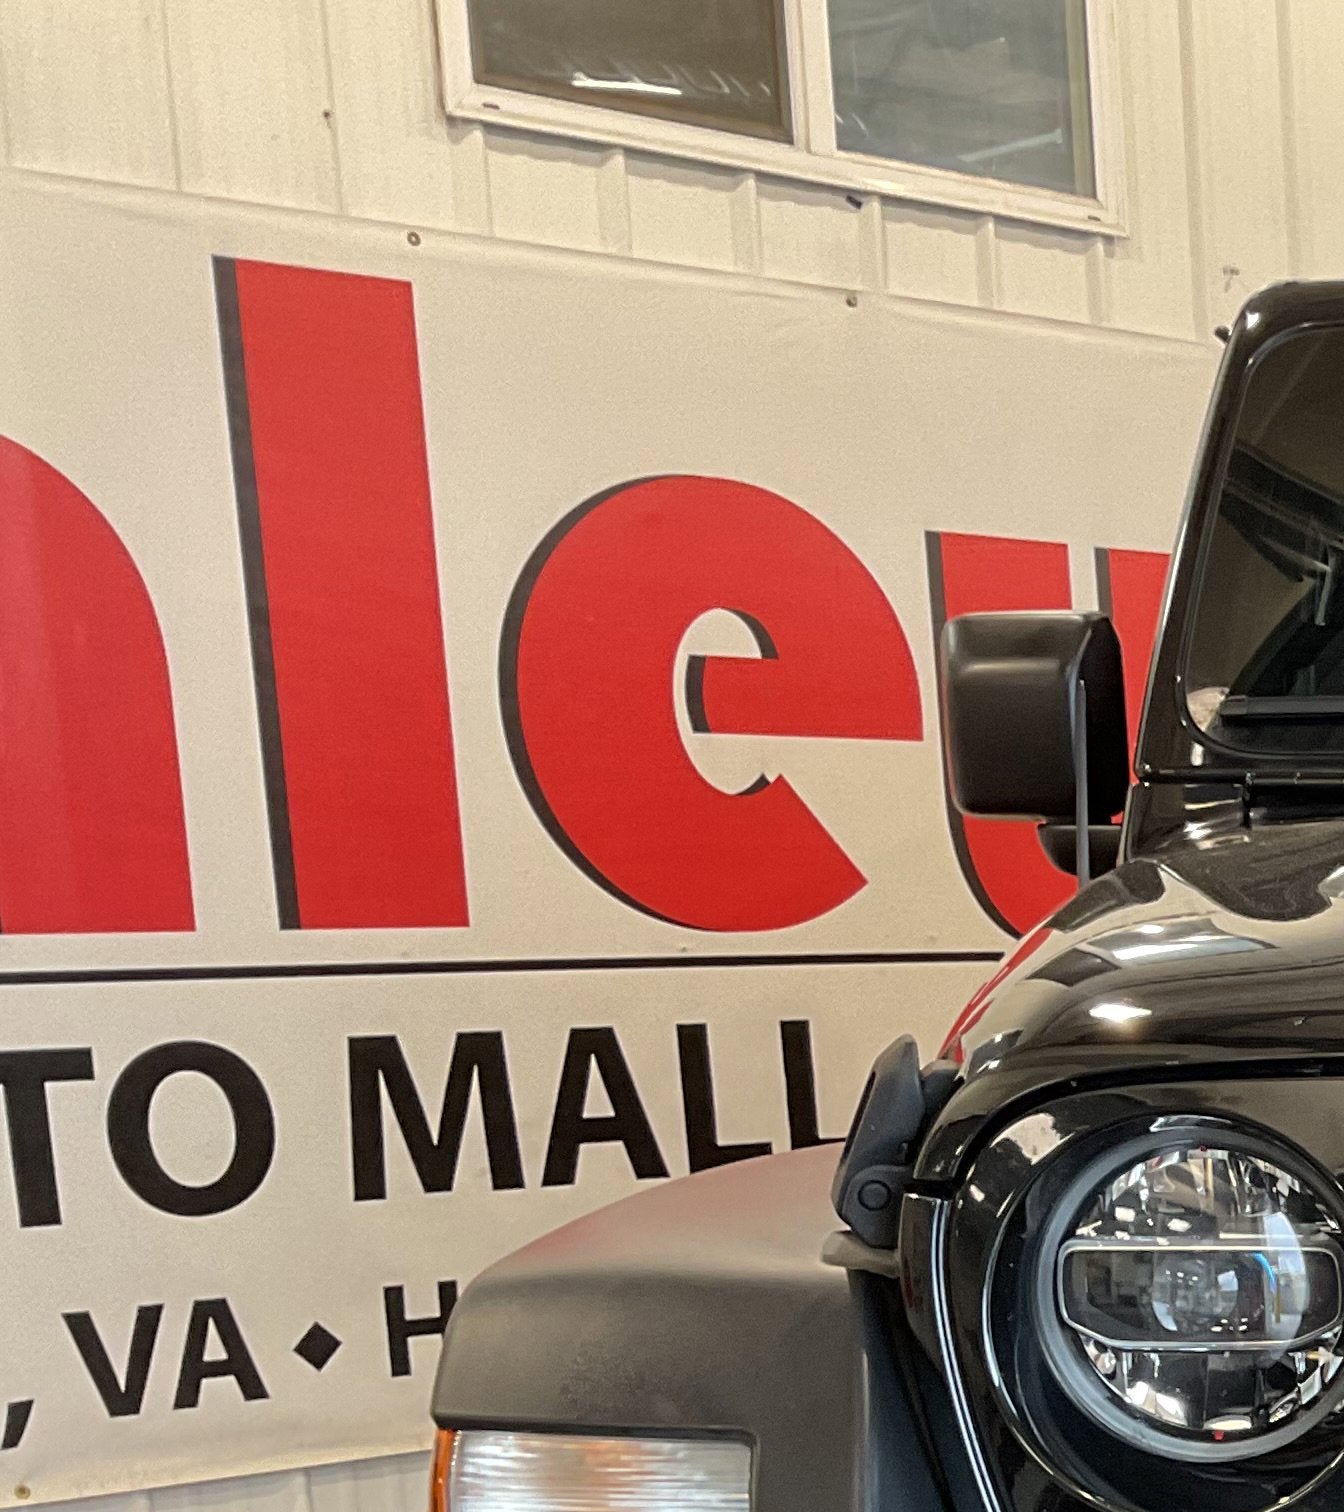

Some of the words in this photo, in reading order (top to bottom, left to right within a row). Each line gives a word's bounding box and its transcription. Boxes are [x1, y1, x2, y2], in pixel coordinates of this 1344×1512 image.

[0, 1040, 275, 1228] TO
[348, 1019, 846, 1202] MALL
[61, 1297, 269, 1418] VA
